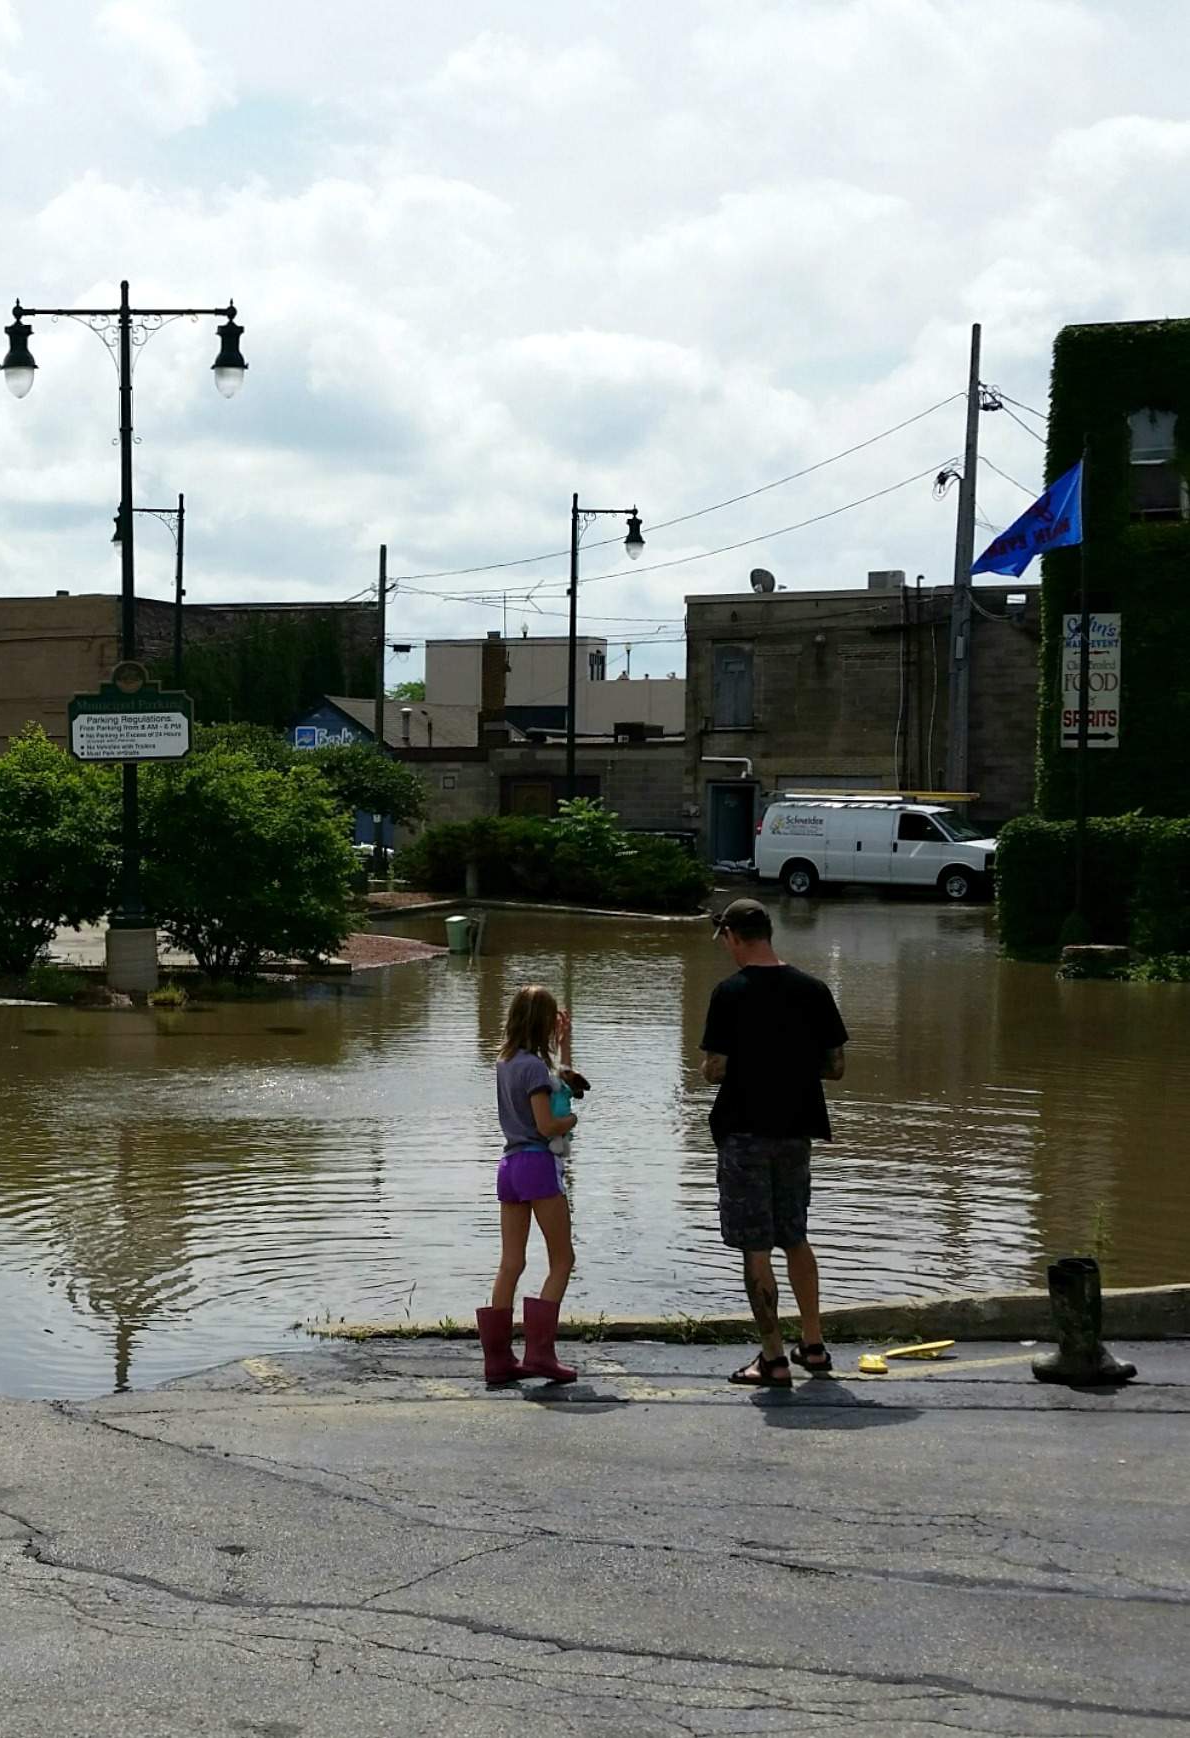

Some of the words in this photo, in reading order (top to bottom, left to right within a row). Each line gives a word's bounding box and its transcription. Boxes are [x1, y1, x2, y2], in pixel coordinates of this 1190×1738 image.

[86, 715, 119, 725] Parking
[1063, 709, 1117, 727] SPRITS
[96, 724, 122, 732] Parking
